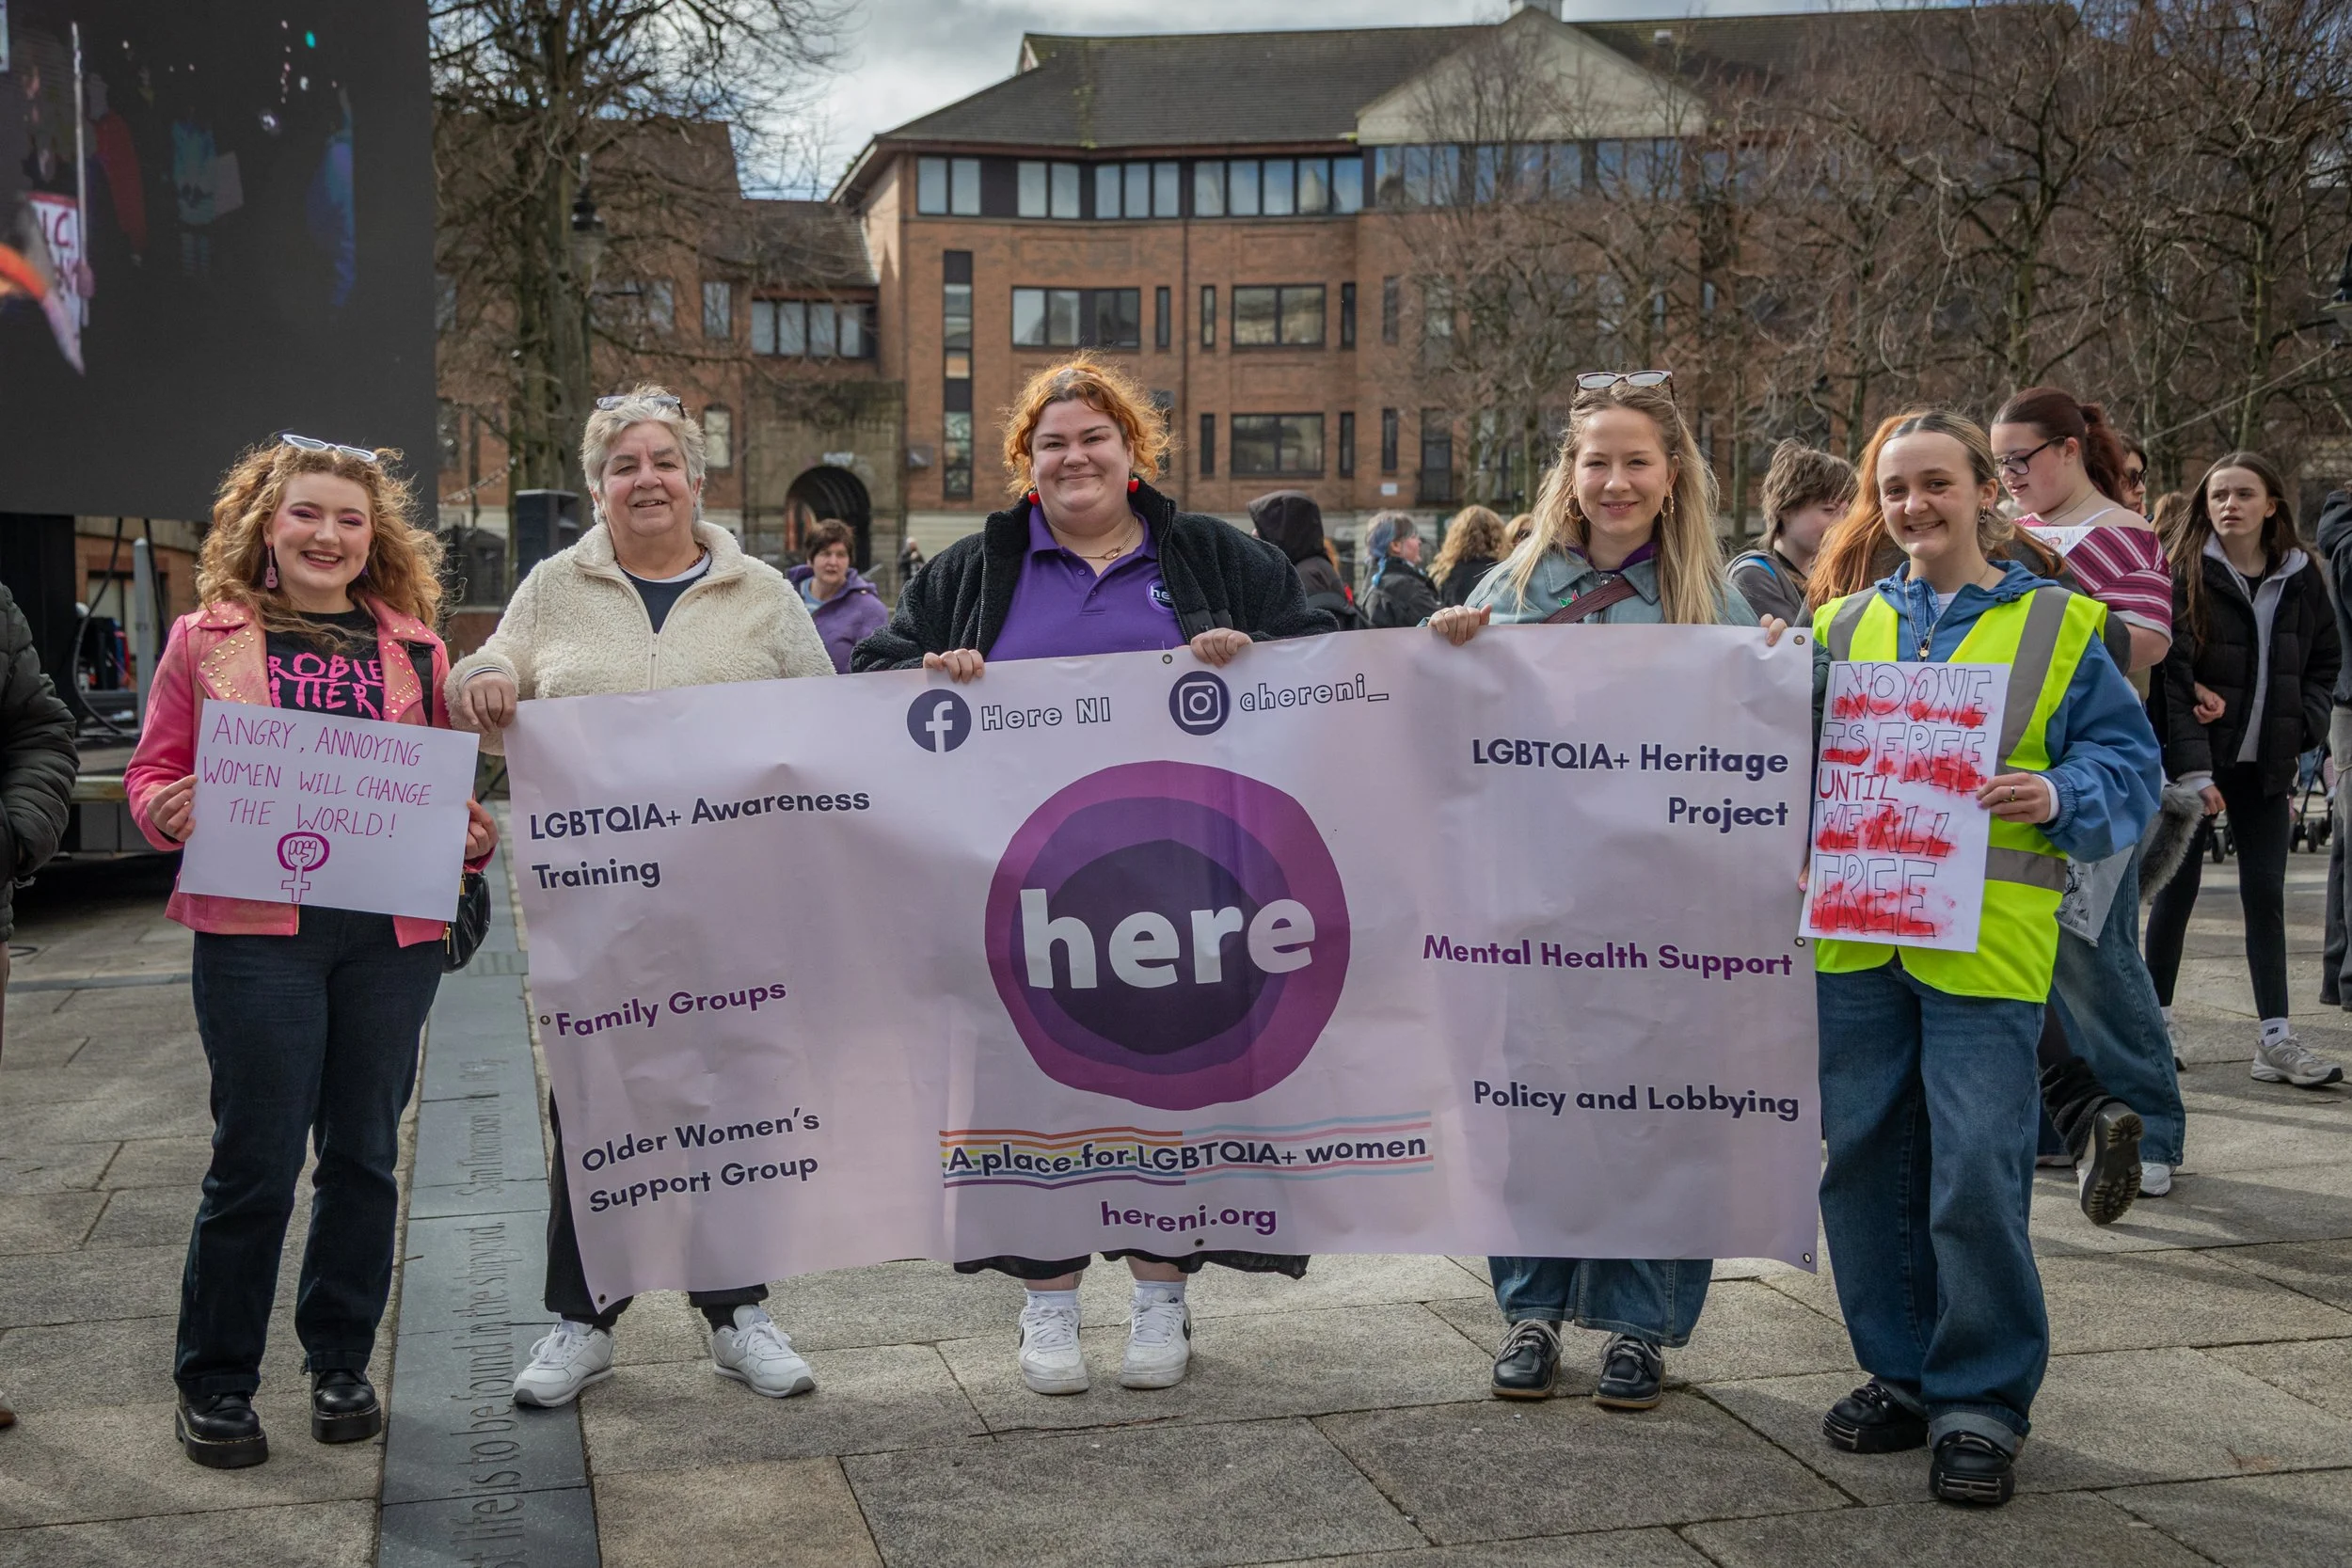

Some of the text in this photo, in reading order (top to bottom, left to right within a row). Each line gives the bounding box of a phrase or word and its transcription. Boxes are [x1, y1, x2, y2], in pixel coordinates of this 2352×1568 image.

[1151, 585, 1170, 599] he
[268, 652, 384, 687] ROBLE
[1239, 673, 1390, 712] @hereni_
[980, 696, 1112, 732] Here NI
[314, 726, 423, 767] ANNOYING
[1472, 738, 1788, 782] LGBTQIA+ Heritage
[1820, 722, 1987, 793] IS FREE
[203, 756, 432, 806] WOMEN WILL CHANGE
[1817, 768, 1899, 801] UNTIL
[230, 799, 396, 838] THE WORLD!
[530, 792, 871, 840] LGBTQIA+ Awareness
[1668, 797, 1788, 833] Project
[1815, 800, 1952, 858] WE ALL
[532, 858, 661, 889] Training
[1809, 854, 1938, 938] FREE
[1019, 888, 1316, 990] here
[1422, 934, 1793, 980] Mental Health Support
[555, 983, 787, 1037] Family Groups
[1473, 1080, 1800, 1122] Policy and Lobbying
[581, 1107, 820, 1171] Older Women's
[947, 1136, 1427, 1175] A place for LGBTQIA+ women
[589, 1157, 818, 1212] Support Group
[1100, 1201, 1278, 1236] hereni.org
[450, 1341, 516, 1401] found
[450, 1403, 519, 1435] be
[456, 1440, 521, 1467] to
